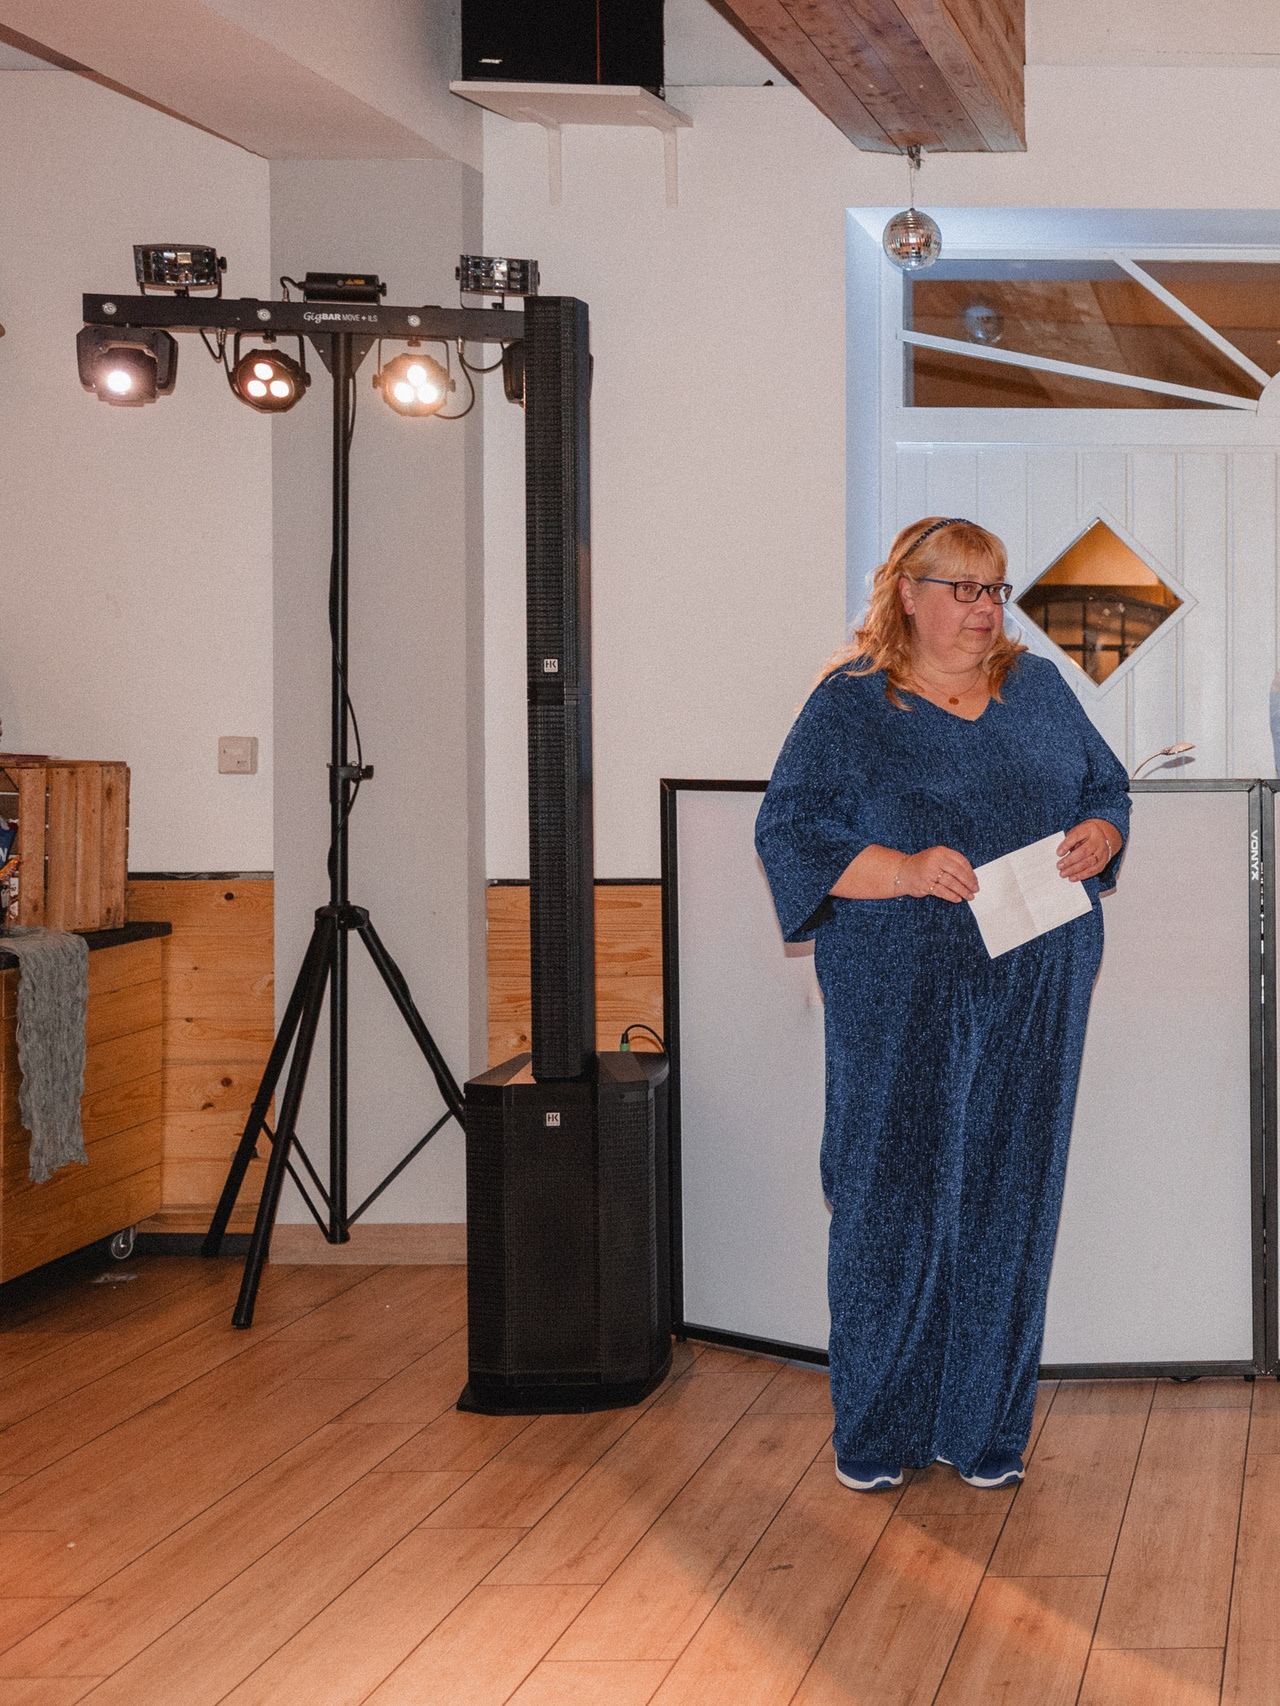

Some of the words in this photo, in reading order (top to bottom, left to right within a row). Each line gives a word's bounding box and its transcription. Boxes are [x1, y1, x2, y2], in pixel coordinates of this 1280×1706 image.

[303, 311, 341, 324] GigBAR
[342, 314, 360, 322] MOVE
[1251, 829, 1259, 881] VONYX
